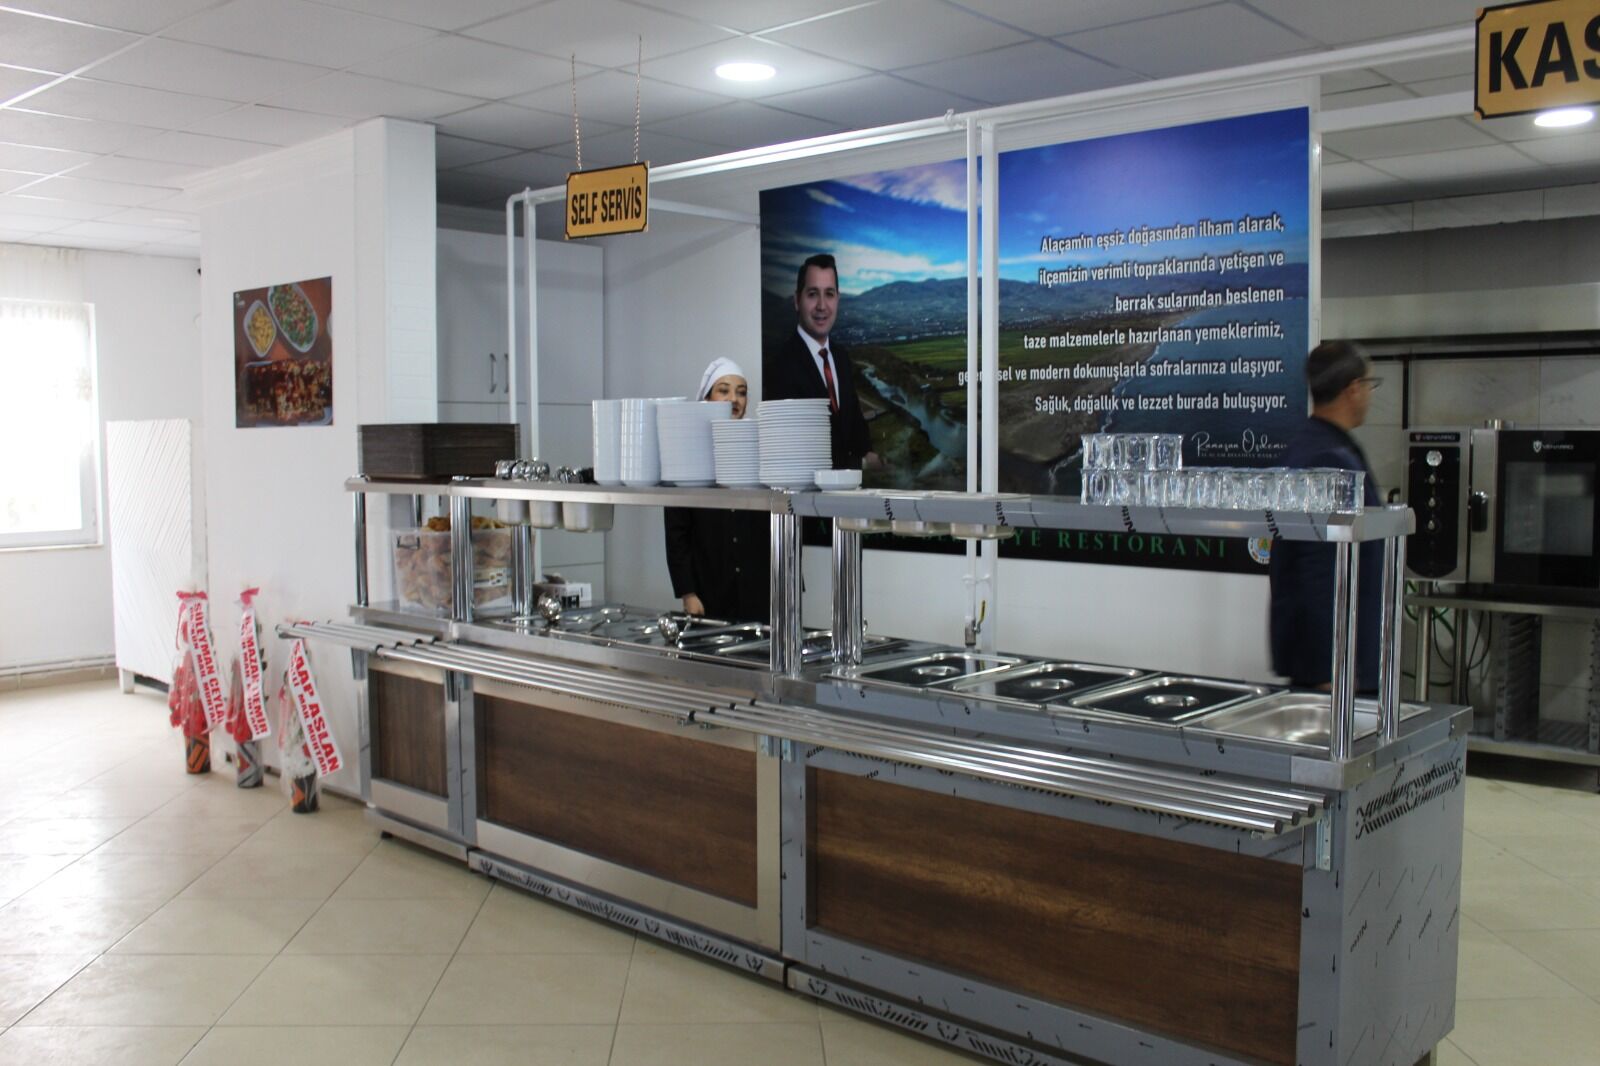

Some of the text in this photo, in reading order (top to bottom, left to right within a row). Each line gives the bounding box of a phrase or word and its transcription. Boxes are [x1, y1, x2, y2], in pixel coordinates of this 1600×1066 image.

[571, 177, 642, 226] SELF SERVİS
[1041, 213, 1285, 254] Alaçam'ın eşsiz doğasından ilham alarak,
[1039, 251, 1284, 289] ilçemizin verimli topraklarında yetişen ve
[1115, 286, 1284, 312] berrak sularından beslenen
[1023, 320, 1284, 349] taze malzemelerle hazırlanan yemeklerimiz,
[1015, 368, 1027, 380] ve
[1030, 364, 1070, 380] modern
[1073, 360, 1147, 382] dokunuşlarla
[1150, 358, 1227, 377] sofralarınıza
[1230, 357, 1284, 378] ulaşıyor.
[1035, 391, 1288, 415] Sağlık, doğallık ve lezzet burada buluşuyor.
[1057, 531, 1226, 558] RESTORANI
[308, 702, 341, 774] ASLAN
